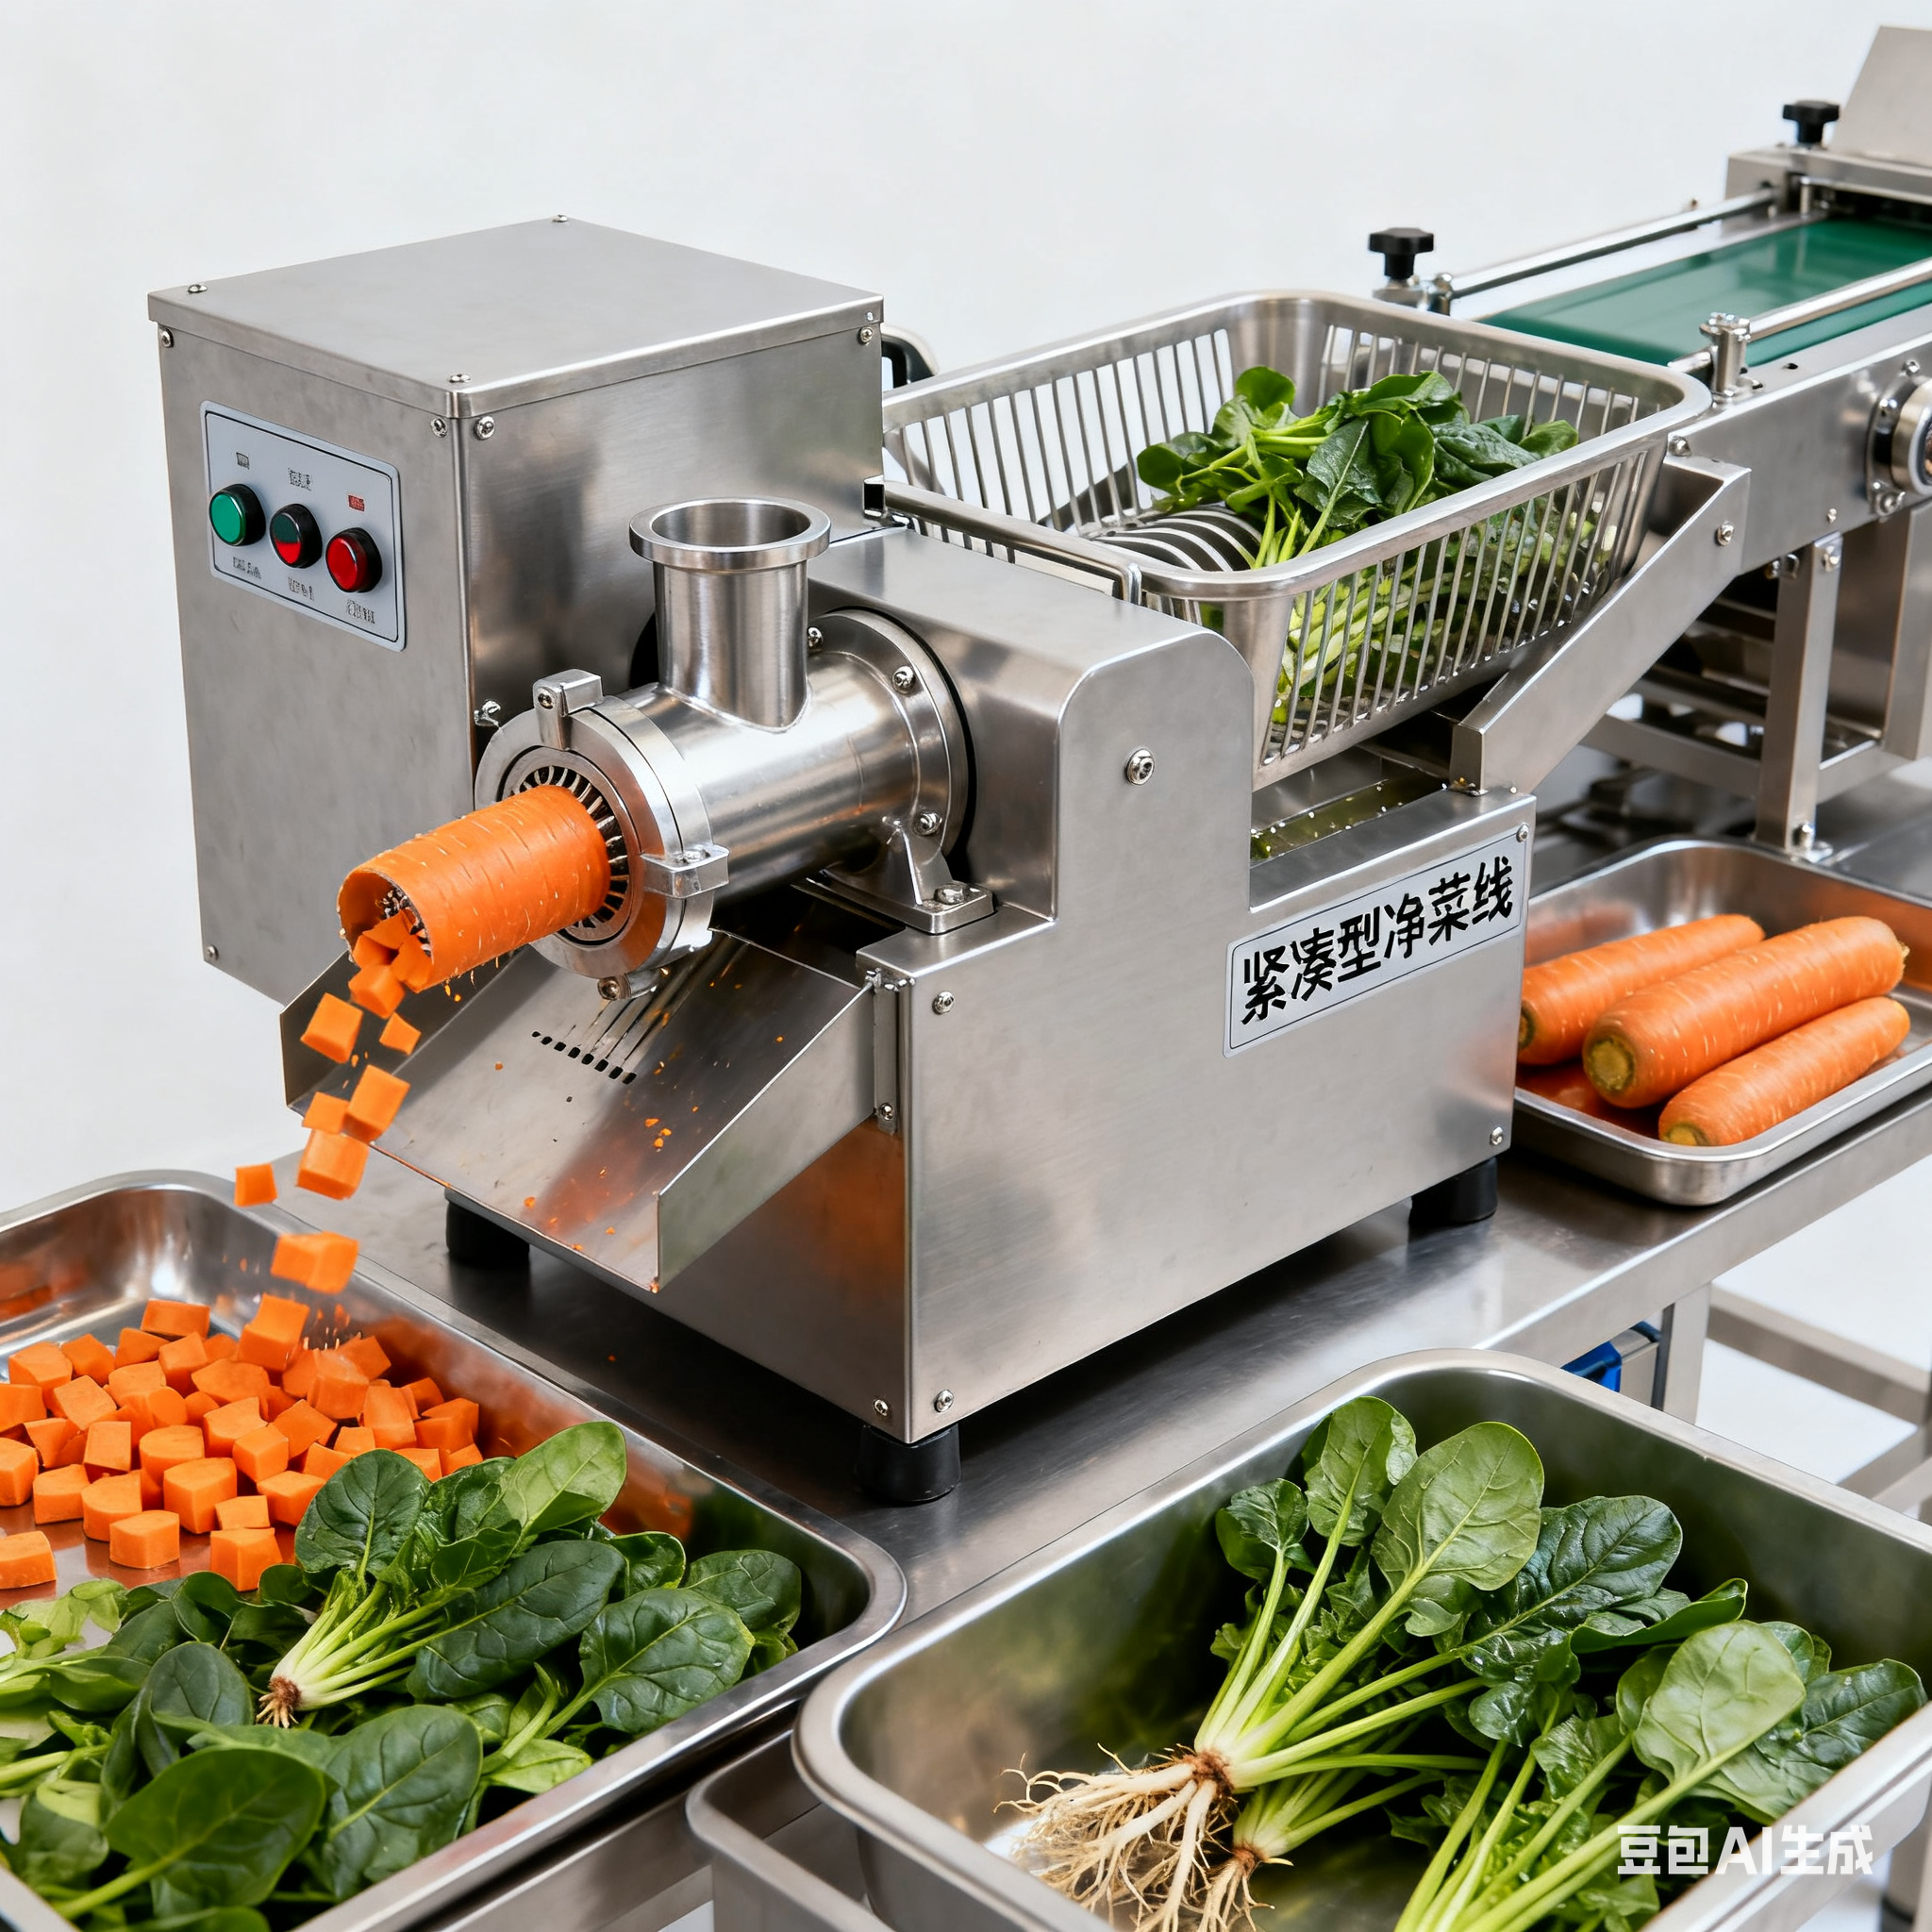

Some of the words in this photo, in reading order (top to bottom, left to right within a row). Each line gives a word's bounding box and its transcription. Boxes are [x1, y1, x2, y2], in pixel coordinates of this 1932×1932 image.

[1241, 856, 1513, 1024] 紧凑型净菜线
